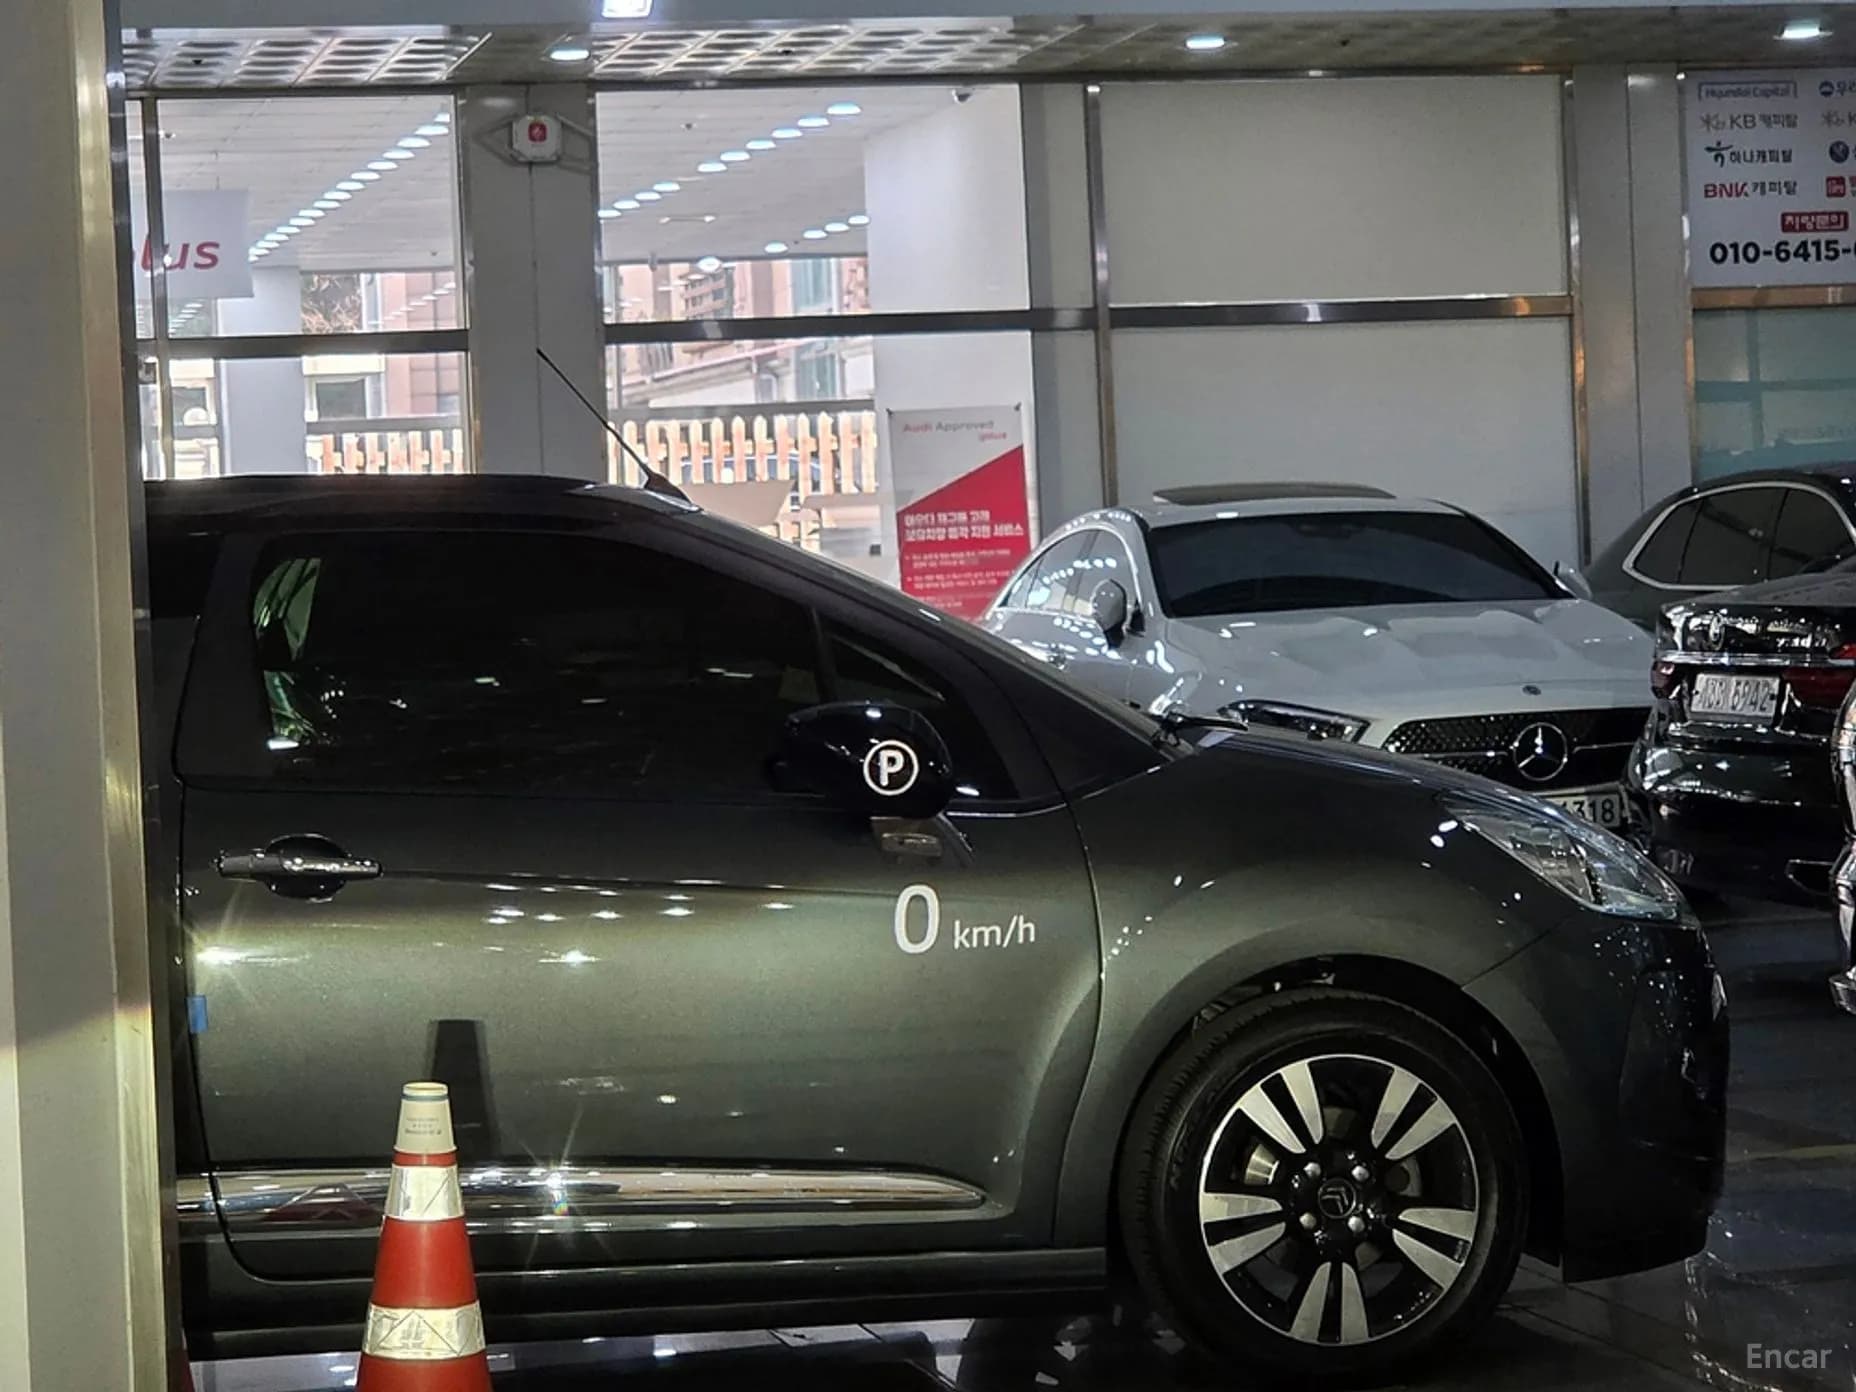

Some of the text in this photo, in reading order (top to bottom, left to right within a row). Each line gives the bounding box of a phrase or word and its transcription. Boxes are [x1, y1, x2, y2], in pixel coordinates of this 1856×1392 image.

[1729, 113, 1757, 129] KB
[1703, 181, 1749, 198] BNK
[936, 420, 995, 432] Approved
[879, 750, 904, 786] P
[895, 884, 1036, 954] 0 km/h
